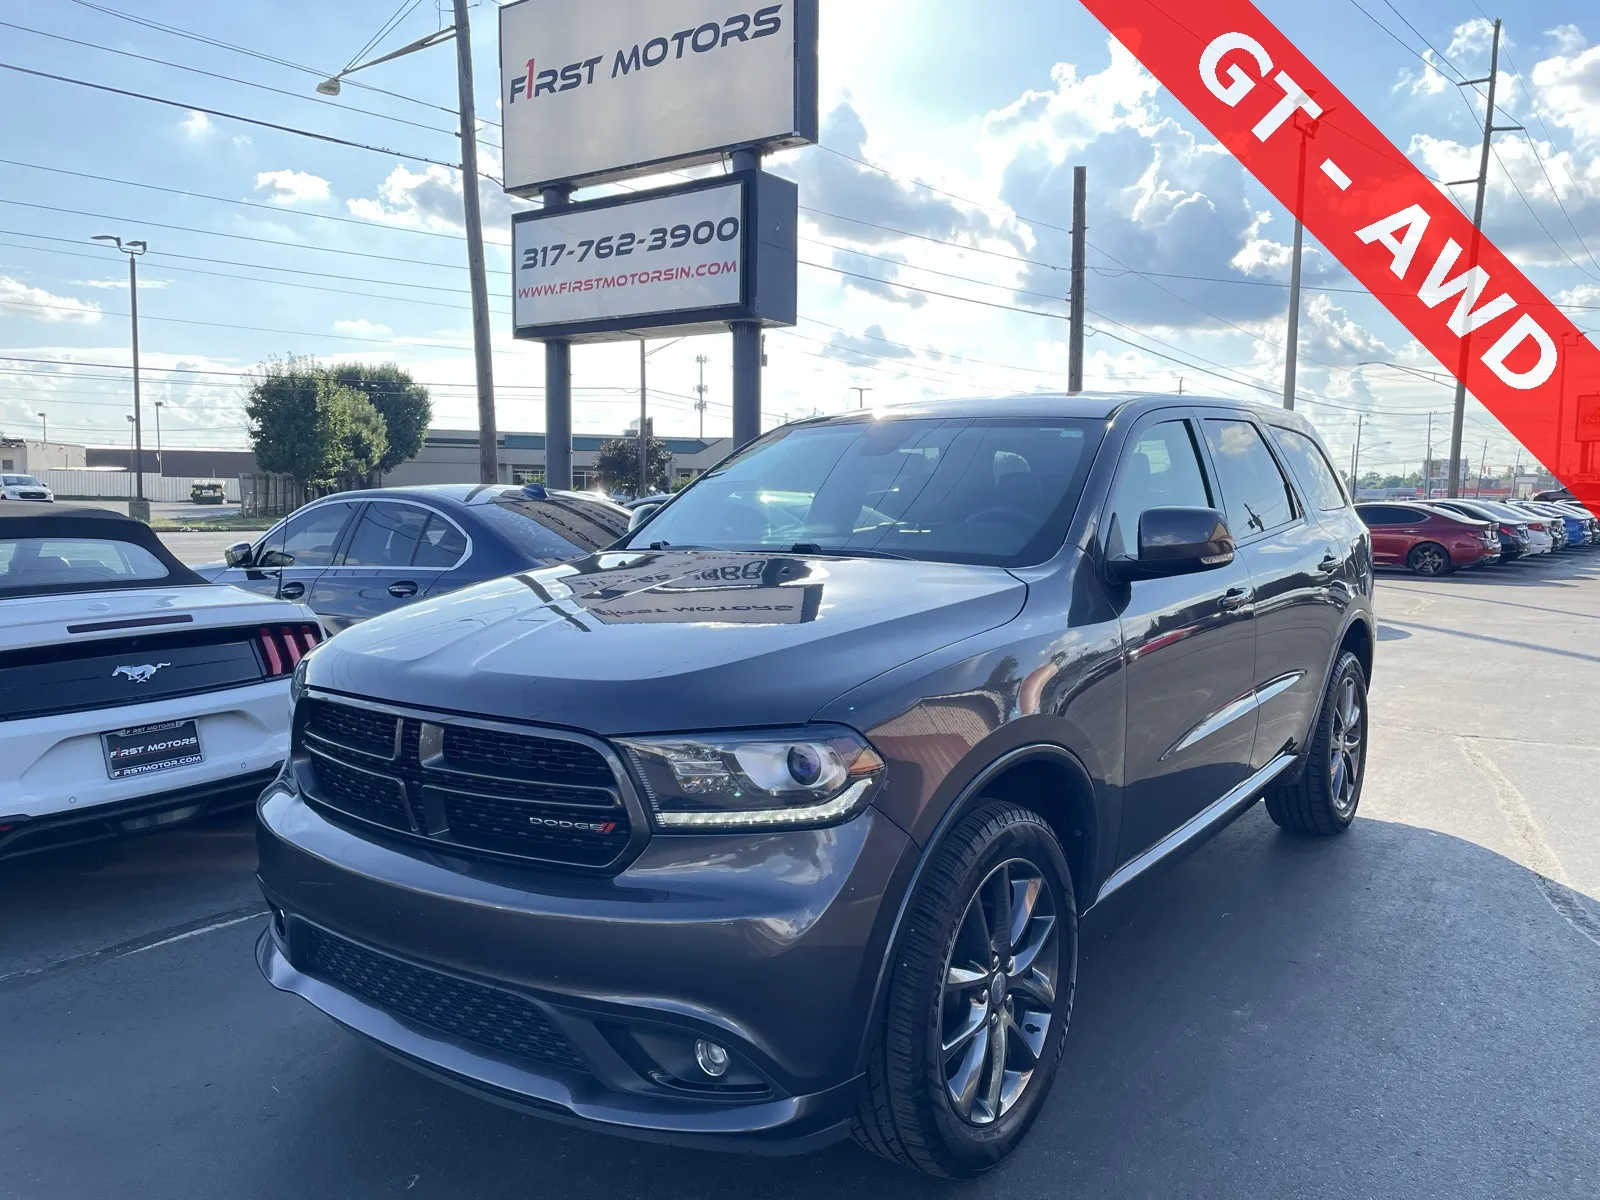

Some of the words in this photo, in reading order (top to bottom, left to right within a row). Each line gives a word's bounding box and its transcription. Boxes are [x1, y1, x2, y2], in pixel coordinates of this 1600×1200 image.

[611, 4, 783, 79] MOTORS
[520, 216, 740, 270] 317-762-3900
[518, 260, 737, 299] WWW.FIRSTMOTORSIN.COM
[147, 722, 175, 731] MOTORS
[147, 737, 197, 752] MOTORS
[529, 817, 604, 831] DODGE
